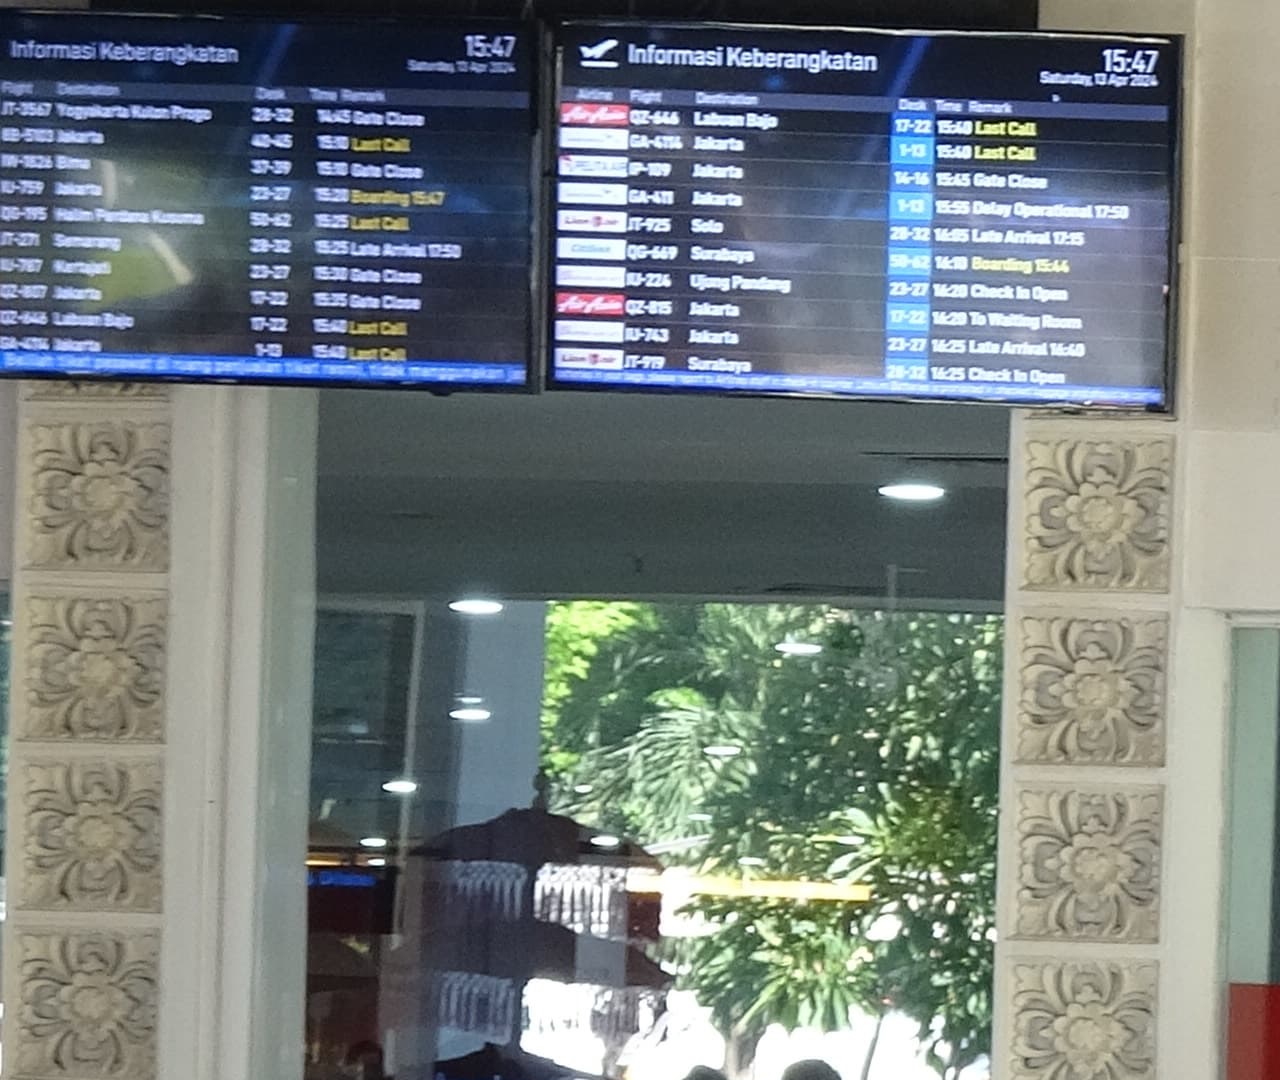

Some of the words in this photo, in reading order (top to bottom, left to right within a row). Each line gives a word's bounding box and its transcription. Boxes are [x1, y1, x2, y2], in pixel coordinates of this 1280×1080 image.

[10, 40, 96, 59] Informasi
[99, 41, 239, 65] Keberangkatan
[465, 35, 516, 57] 15:47
[628, 43, 723, 66] Informasi
[726, 47, 878, 74] Keberangkatan
[1102, 49, 1160, 74] 15:47
[1040, 70, 1093, 87] Saturday,
[1093, 72, 1107, 85] 13
[1107, 73, 1129, 88] Apr
[629, 90, 662, 104] Flight
[695, 90, 759, 106] Destination
[898, 98, 927, 112] Desk
[934, 99, 963, 112] Time
[968, 100, 1013, 114] Remark
[746, 111, 779, 130] Bajo
[895, 119, 932, 133] 17-22
[974, 121, 1005, 136] Last
[1007, 121, 1038, 137] Call
[693, 136, 745, 152] Jakarta
[973, 146, 1005, 161] Last
[1006, 146, 1037, 161] Call
[692, 163, 743, 179] Jakarta
[973, 173, 1006, 188] Gate
[1007, 173, 1049, 189] Close
[691, 191, 743, 207] Jakarta
[972, 201, 1011, 219] Delay
[1013, 202, 1092, 220] Operational
[1094, 204, 1129, 220] 17:50
[690, 218, 725, 234] Solo
[972, 228, 1003, 244] Late
[1004, 229, 1051, 245] Arrival
[690, 245, 755, 264] Surabaya
[971, 257, 1033, 275] Boarding
[689, 272, 730, 292] Ujung
[731, 275, 792, 294] Pandang
[888, 282, 929, 298] 23-27
[970, 284, 1014, 300] Check
[1016, 285, 1031, 300] In
[1032, 285, 1069, 303] Open
[689, 301, 740, 318] Jakarta
[969, 312, 987, 327] To
[988, 312, 1040, 331] Waiting
[1041, 314, 1083, 330] Room
[688, 329, 739, 345] Jakarta
[887, 337, 928, 352] 23-27
[968, 340, 1000, 356] Late
[1001, 341, 1049, 357] Arrival
[687, 356, 752, 374] Surabaya
[968, 367, 1012, 383] Check
[1013, 368, 1028, 383] In
[1029, 369, 1066, 386] Open
